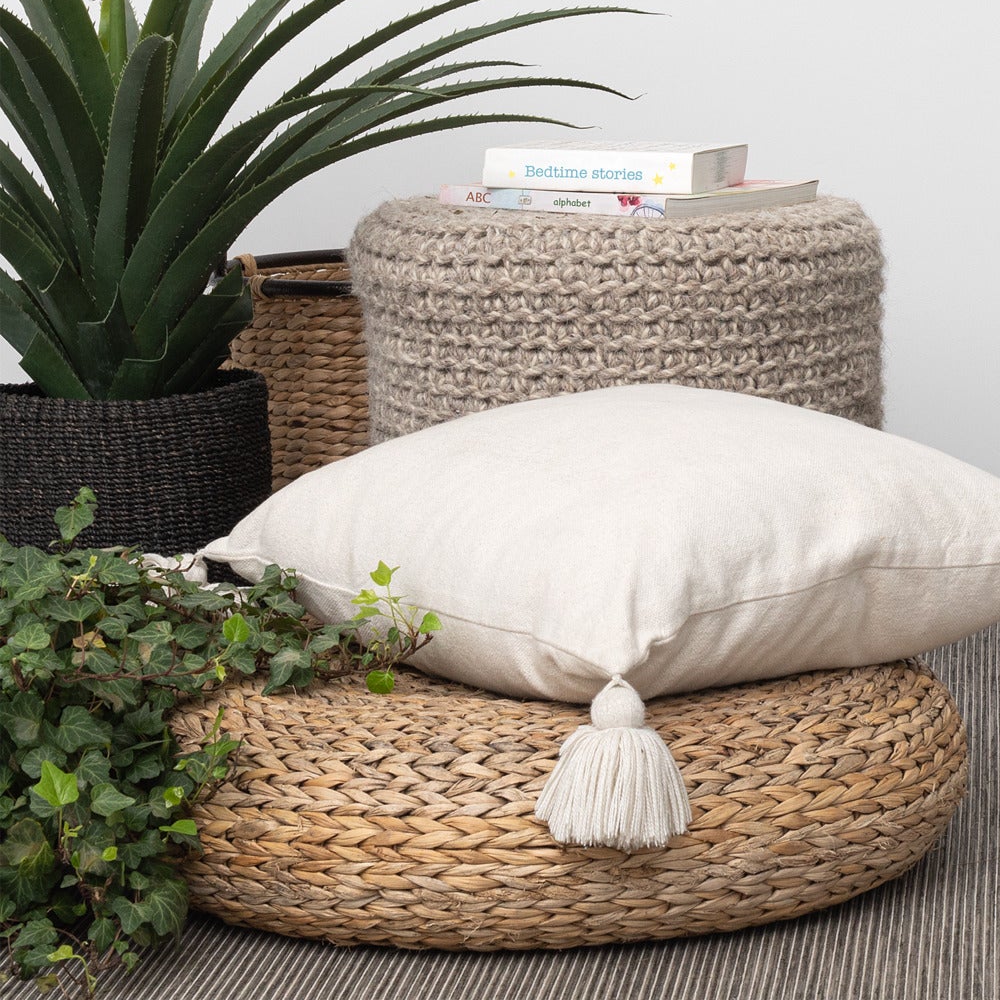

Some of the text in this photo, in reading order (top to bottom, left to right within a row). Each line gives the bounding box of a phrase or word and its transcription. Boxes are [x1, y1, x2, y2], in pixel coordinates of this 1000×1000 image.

[525, 165, 643, 181] Bedtime stories
[465, 191, 492, 204] ABC
[553, 198, 591, 208] alphabet
